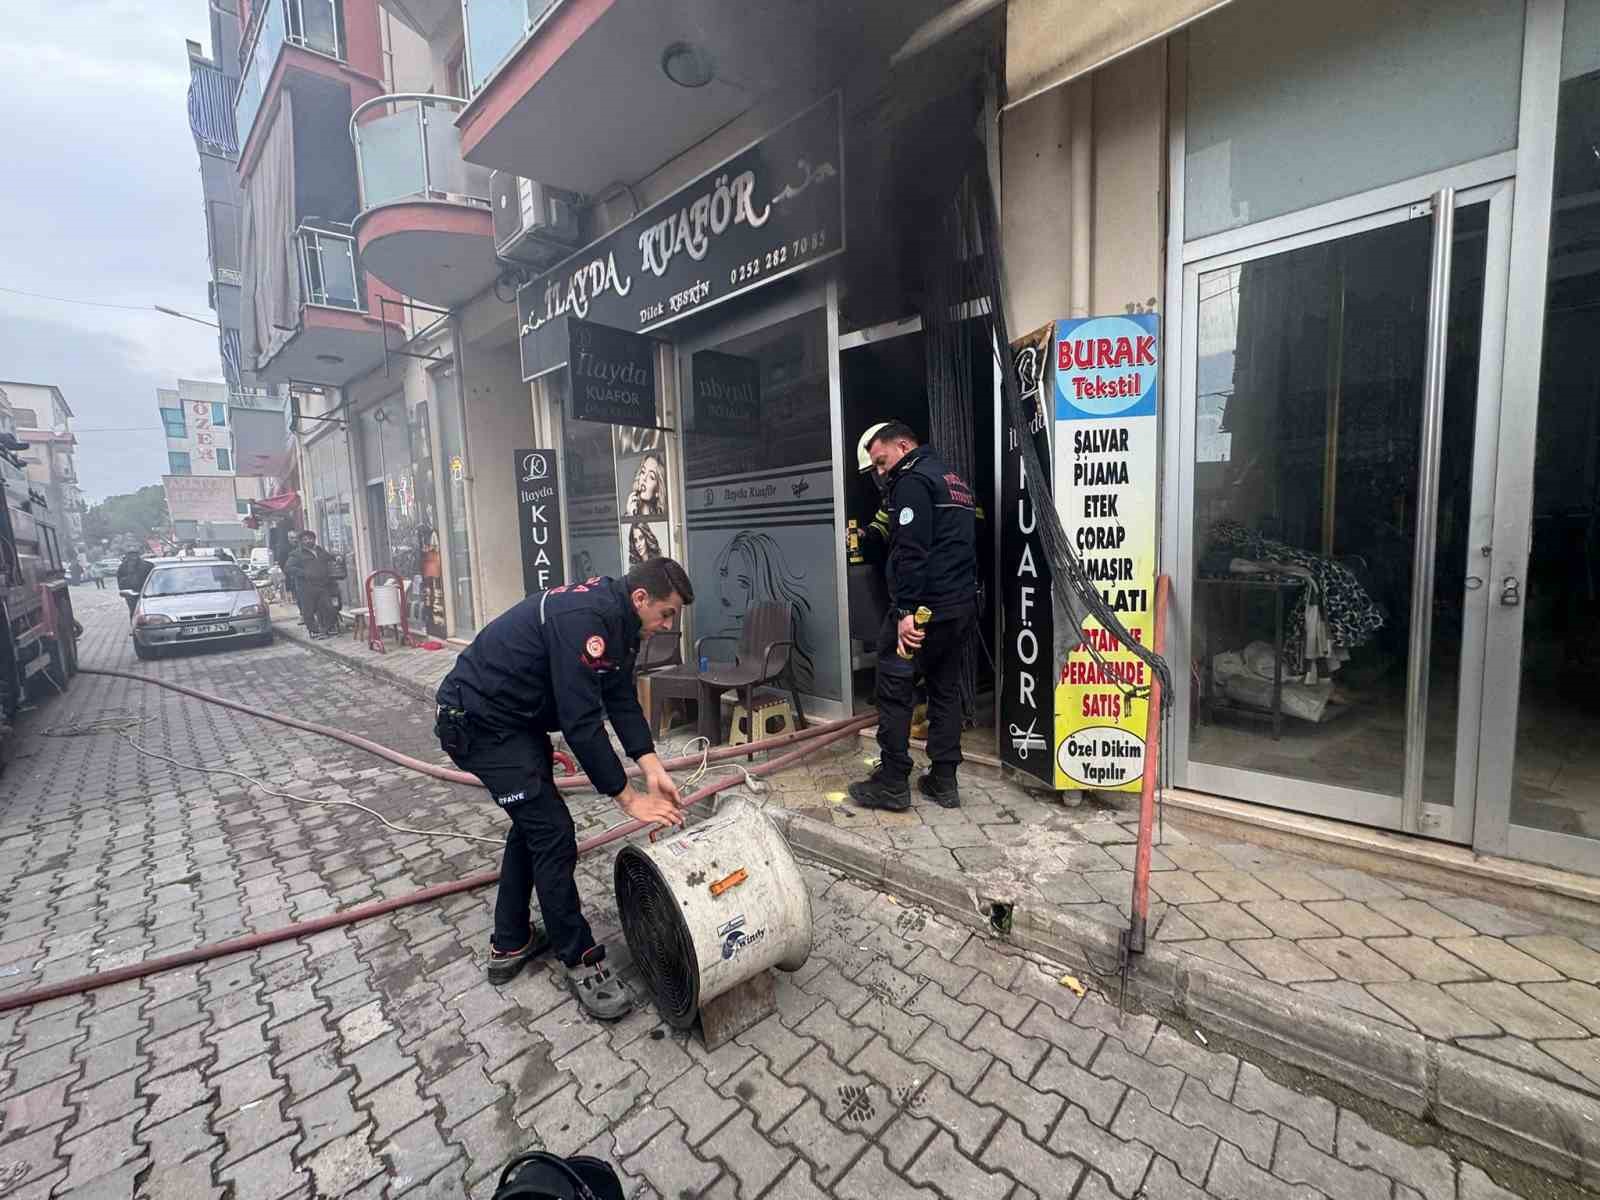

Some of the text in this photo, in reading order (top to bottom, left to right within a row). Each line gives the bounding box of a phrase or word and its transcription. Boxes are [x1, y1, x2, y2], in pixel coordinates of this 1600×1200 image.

[544, 170, 771, 320] İLAYDA KUAFÖR
[765, 245, 787, 269] 282
[1057, 335, 1157, 370] BURAK
[1072, 373, 1142, 399] Tekstil
[1074, 428, 1129, 461] ŞALVAR
[1073, 455, 1130, 486] PİJAMA
[1084, 494, 1119, 518] ETEK
[532, 504, 551, 590] KUAF
[1076, 526, 1126, 557] ÇORAP
[1102, 589, 1148, 611] LATI
[1061, 661, 1144, 685] PERAKENDE
[1082, 693, 1121, 724] SATIŞ
[1067, 734, 1141, 758] Özel Dikim
[1082, 762, 1126, 784] Yapılır
